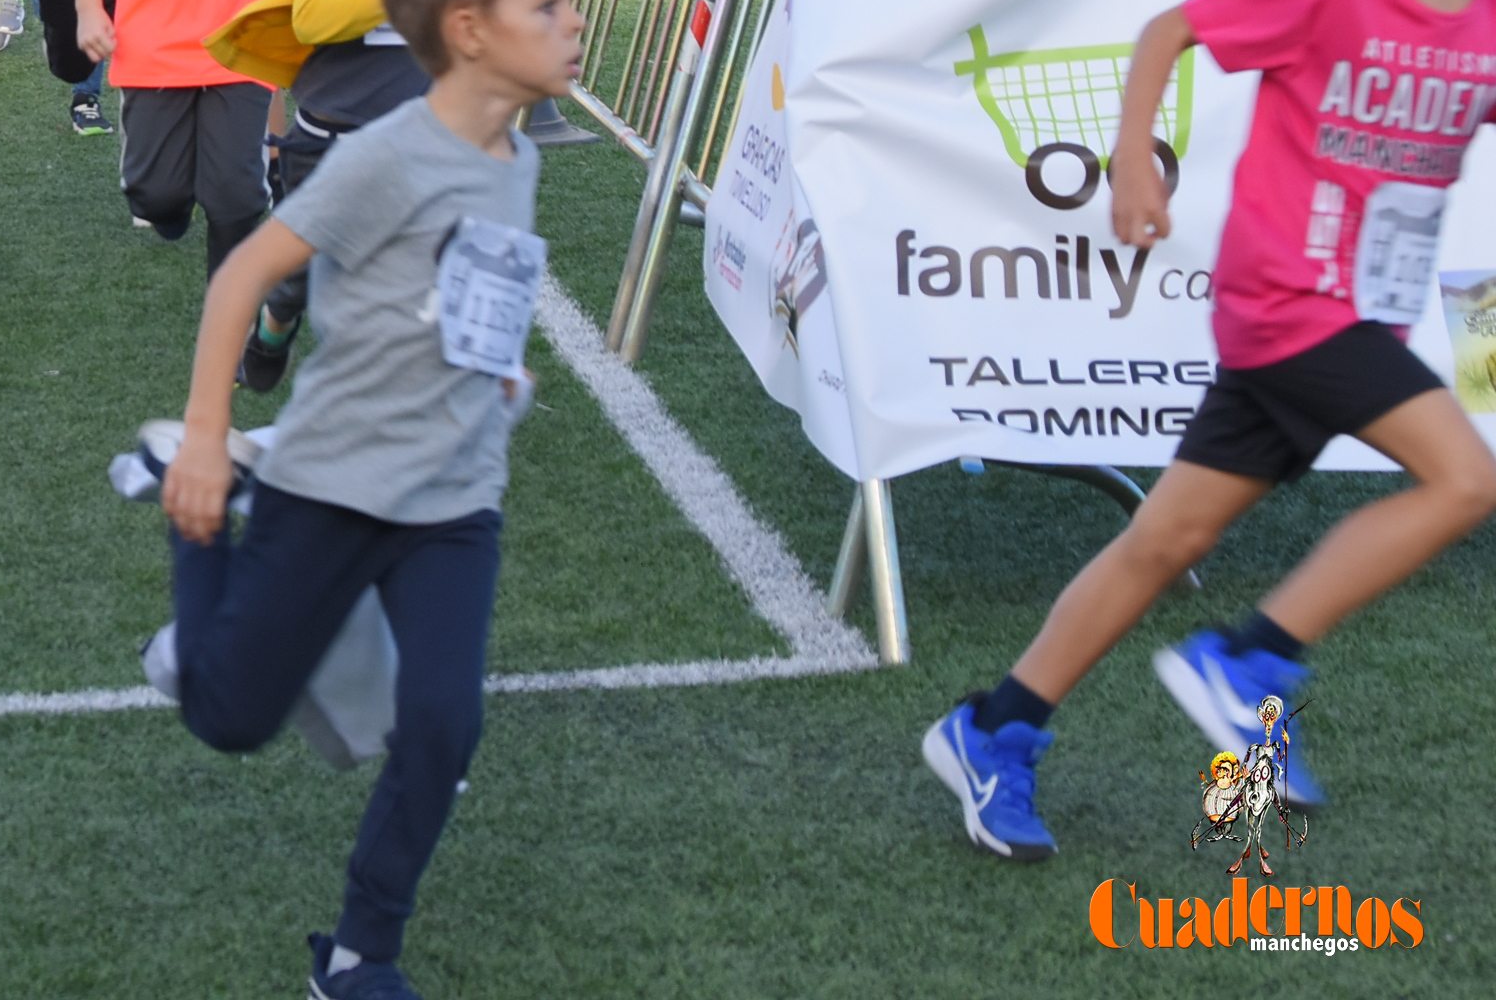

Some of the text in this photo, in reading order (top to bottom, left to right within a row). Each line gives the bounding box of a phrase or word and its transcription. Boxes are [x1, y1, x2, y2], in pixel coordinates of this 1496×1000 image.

[1362, 37, 1496, 77] ATLETISM
[895, 229, 1216, 319] family ca
[928, 356, 1224, 387] TALLERE
[950, 406, 1196, 438] OMING
